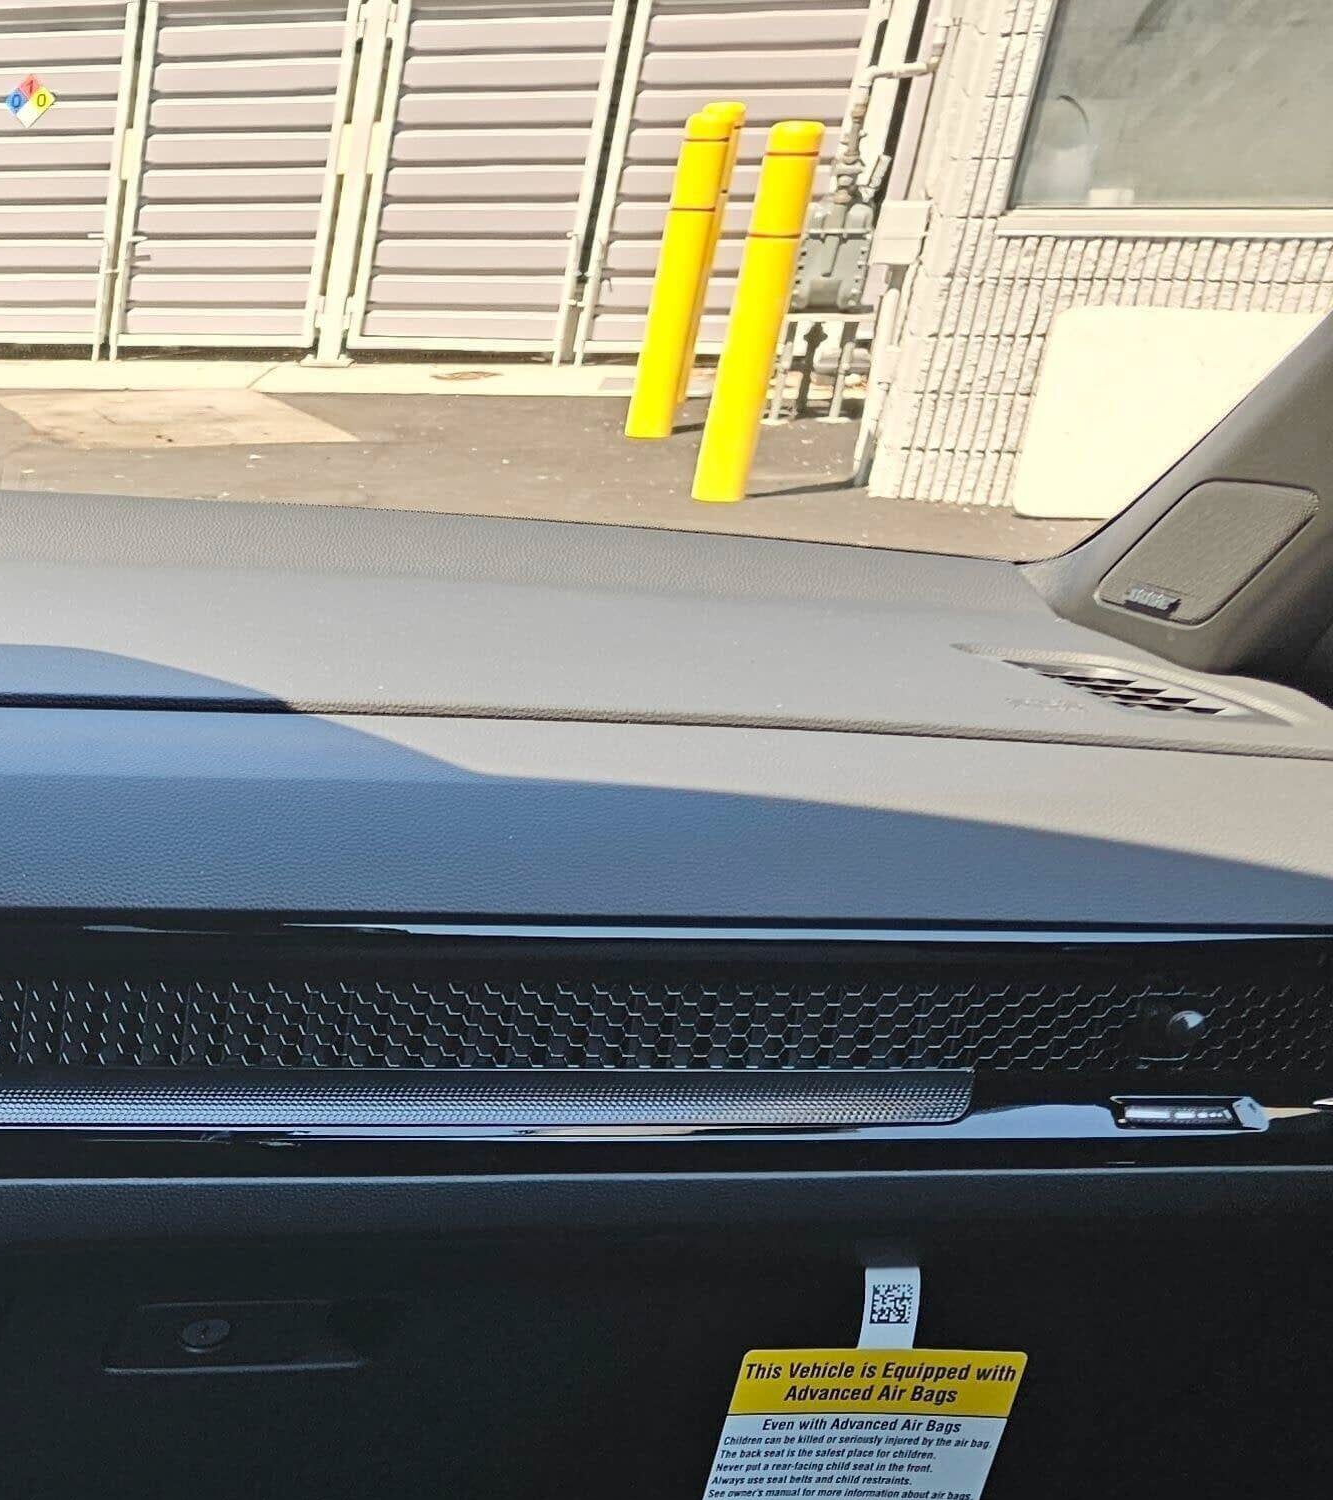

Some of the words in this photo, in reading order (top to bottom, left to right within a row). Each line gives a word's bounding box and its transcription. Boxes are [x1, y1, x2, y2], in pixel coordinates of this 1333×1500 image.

[26, 80, 34, 94] 1
[11, 94, 21, 108] 0
[37, 94, 47, 107] 0
[746, 1363, 782, 1379] This
[789, 1362, 854, 1379] Vehicle
[860, 1362, 877, 1378] is
[882, 1362, 971, 1382] Equipped
[975, 1365, 1017, 1382] with
[783, 1385, 874, 1401] Advanced
[877, 1385, 907, 1400] Air
[910, 1386, 958, 1405] Bags
[762, 1418, 794, 1430] Even
[798, 1418, 827, 1430] with
[830, 1418, 898, 1431] Advanced
[901, 1419, 923, 1431] Air
[926, 1420, 962, 1435] Bags
[723, 1436, 762, 1445] Children
[784, 1436, 795, 1444] be
[797, 1435, 825, 1444] killed
[838, 1435, 883, 1446] seriously
[884, 1436, 920, 1446] injured
[921, 1436, 934, 1447] by
[935, 1437, 952, 1446] the
[954, 1438, 969, 1447] air
[720, 1449, 737, 1458] The
[739, 1448, 761, 1458] back
[763, 1449, 784, 1458] seat
[787, 1449, 796, 1457] is
[798, 1448, 812, 1457] the
[815, 1448, 846, 1457] safest
[847, 1448, 874, 1458] place
[876, 1448, 890, 1458] for
[892, 1450, 937, 1460] children.
[716, 1463, 744, 1472] Never
[745, 1462, 761, 1472] put
[771, 1461, 823, 1472] rear-facing
[825, 1461, 851, 1471] child
[852, 1463, 874, 1471] seat
[876, 1463, 886, 1471] in
[888, 1463, 905, 1472] the
[906, 1463, 933, 1473] front.
[711, 1476, 745, 1486] Always
[766, 1475, 787, 1484] seat
[789, 1475, 812, 1484] belts
[815, 1475, 833, 1484] and
[835, 1475, 860, 1484] child
[861, 1476, 913, 1486] restraints.
[708, 1489, 725, 1498] See
[727, 1488, 763, 1497] owner's
[765, 1488, 800, 1497] manual
[802, 1488, 815, 1497] for
[817, 1489, 842, 1497] more
[843, 1488, 899, 1498] information
[901, 1490, 929, 1499] about
[930, 1491, 944, 1499] air
